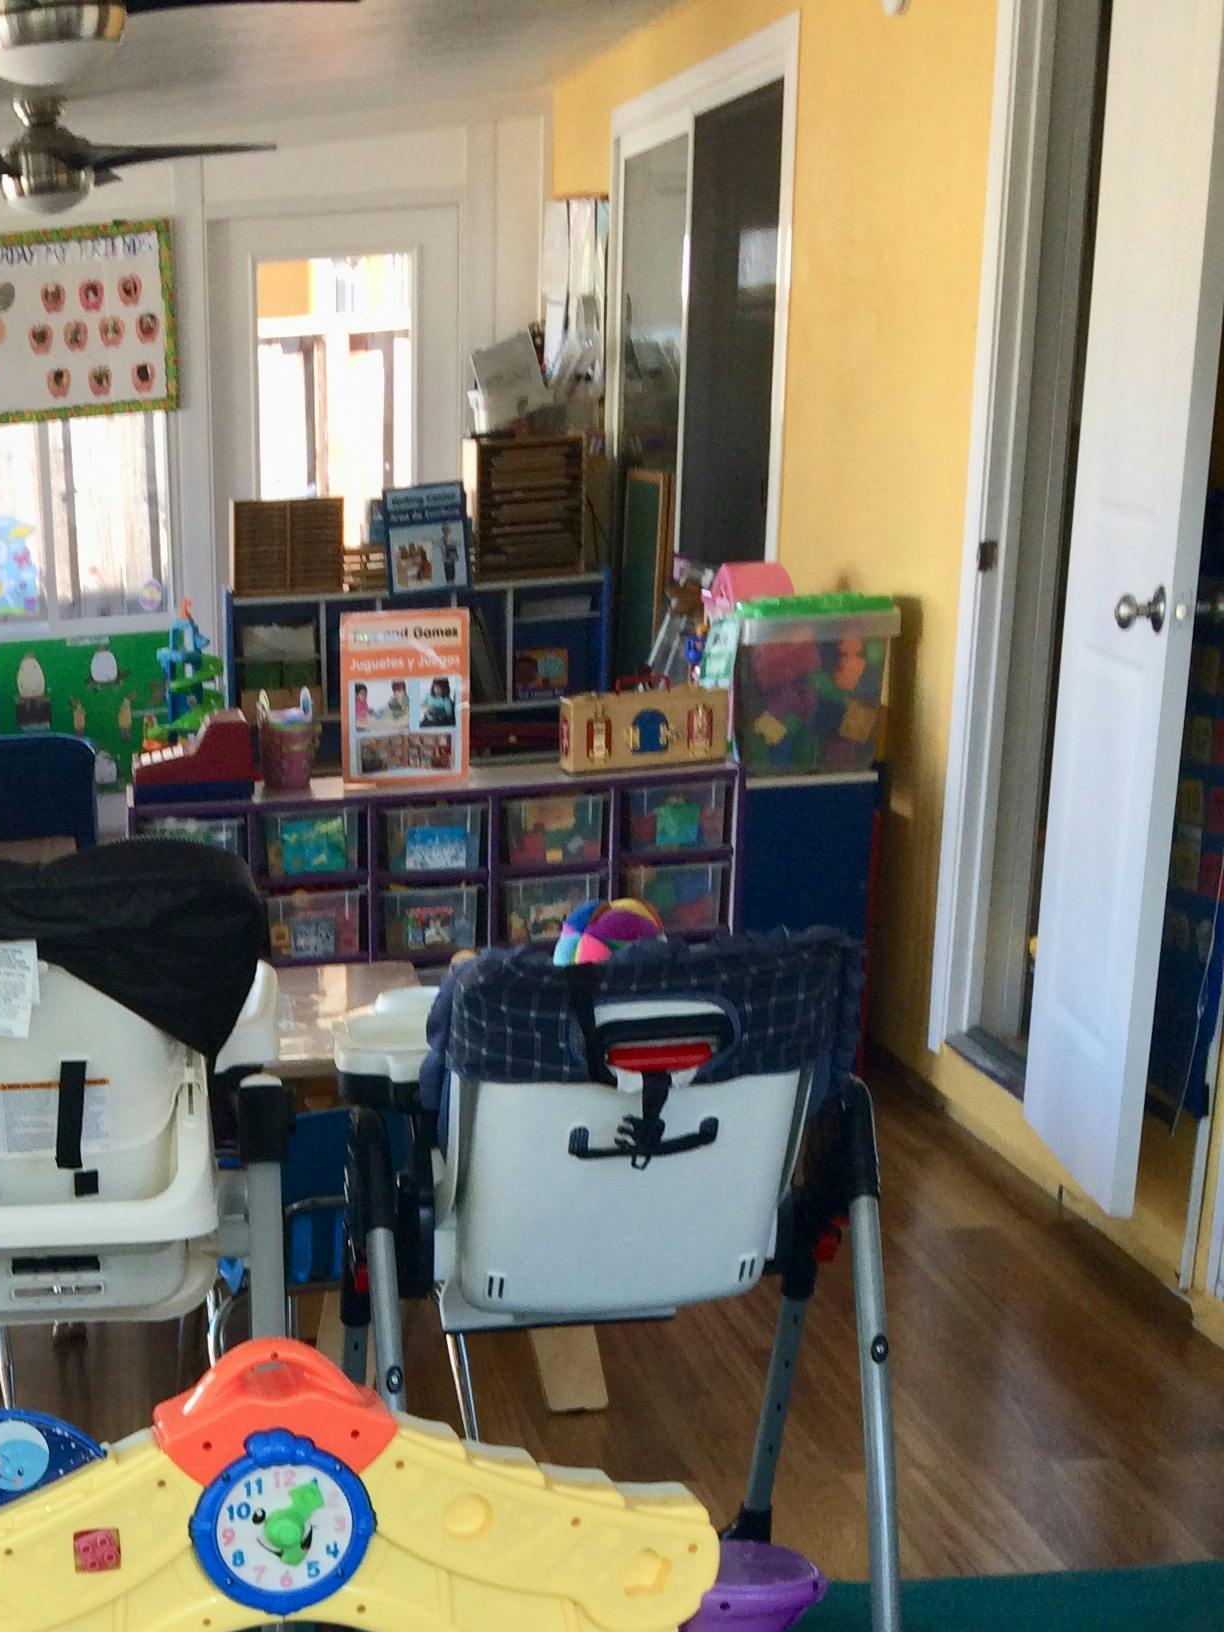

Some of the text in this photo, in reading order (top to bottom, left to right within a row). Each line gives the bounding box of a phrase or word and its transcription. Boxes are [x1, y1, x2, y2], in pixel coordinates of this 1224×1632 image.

[413, 626, 459, 640] Games
[350, 657, 404, 673] Juguetes
[407, 657, 414, 671] y
[244, 1478, 263, 1498] 11
[273, 1471, 296, 1488] 12
[228, 1502, 251, 1521] 10
[222, 1527, 235, 1546] 9
[326, 1541, 339, 1558] 4
[232, 1550, 245, 1567] 8
[254, 1566, 266, 1583] 7
[307, 1561, 320, 1578] 5
[280, 1570, 294, 1587] 6
